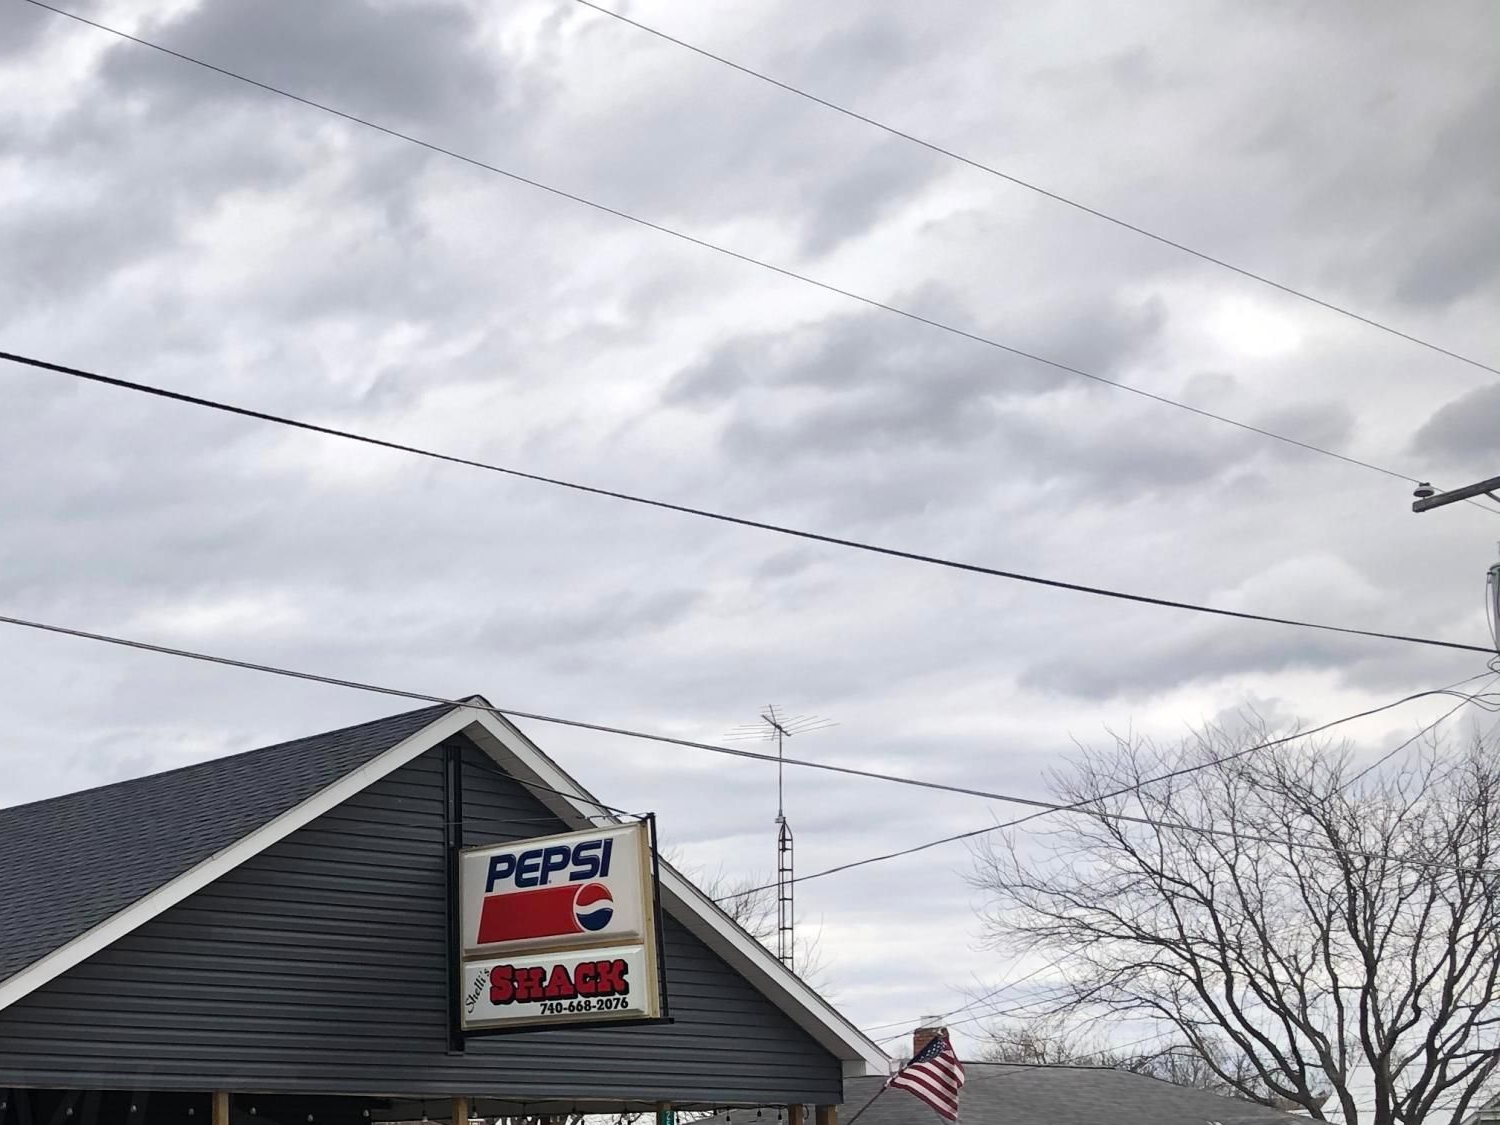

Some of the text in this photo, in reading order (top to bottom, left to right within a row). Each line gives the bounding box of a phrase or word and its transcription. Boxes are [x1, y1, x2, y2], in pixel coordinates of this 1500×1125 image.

[485, 838, 614, 893] PEPSI
[465, 968, 490, 1014] Shelli's
[489, 958, 629, 1005] SHACK
[540, 996, 629, 1015] 740-668-2076
